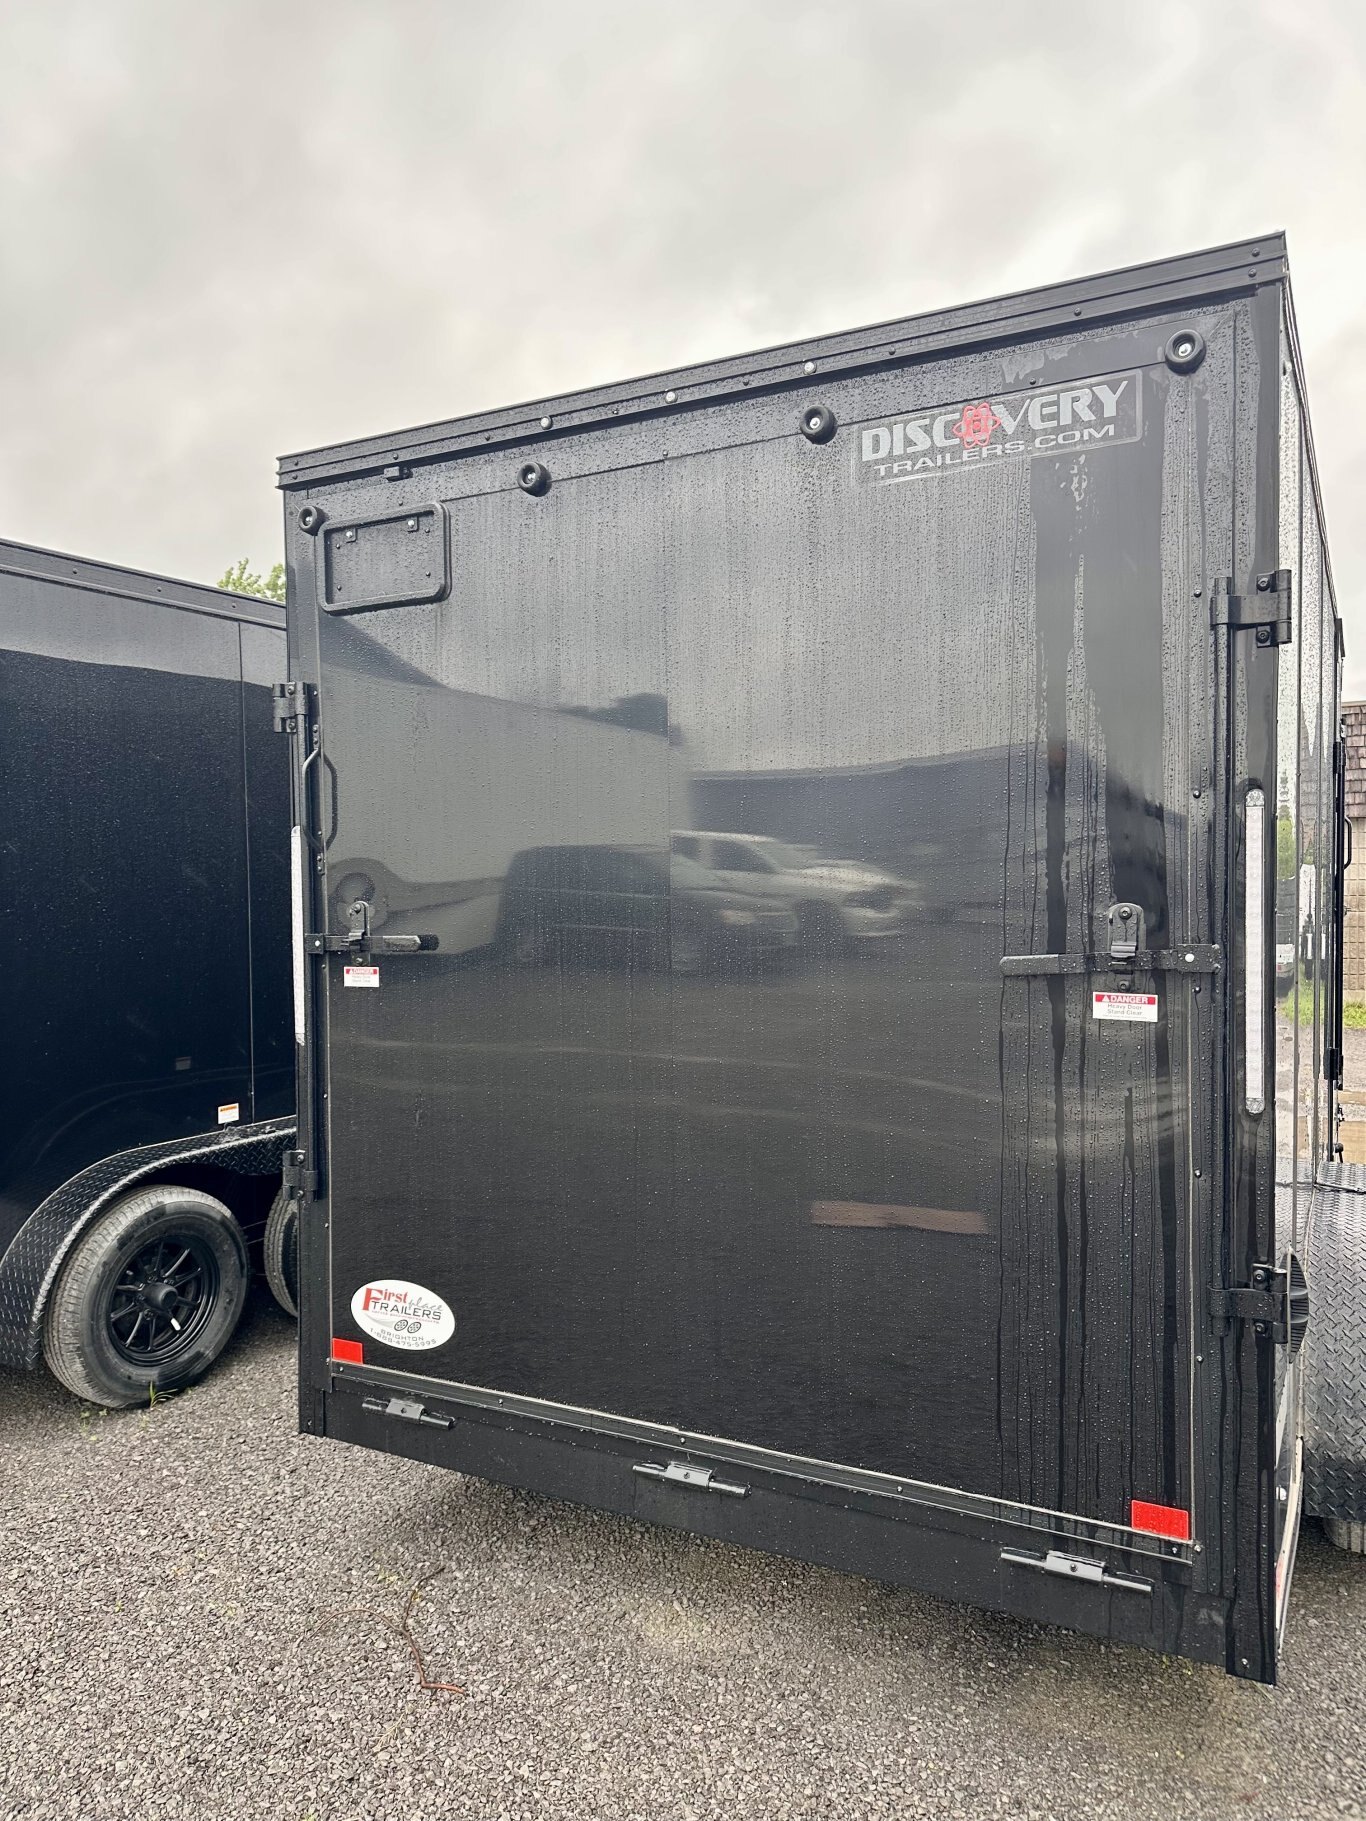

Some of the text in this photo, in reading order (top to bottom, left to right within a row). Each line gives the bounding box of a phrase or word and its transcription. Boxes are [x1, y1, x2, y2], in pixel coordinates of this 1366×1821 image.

[861, 380, 1129, 462] DISCOVERY
[873, 424, 1115, 477] TRAILERS.COM
[1110, 995, 1149, 1004] DANGER
[362, 1287, 443, 1312] First place
[371, 1300, 442, 1321] TRAILERS
[380, 1328, 425, 1341] BRIGHTON
